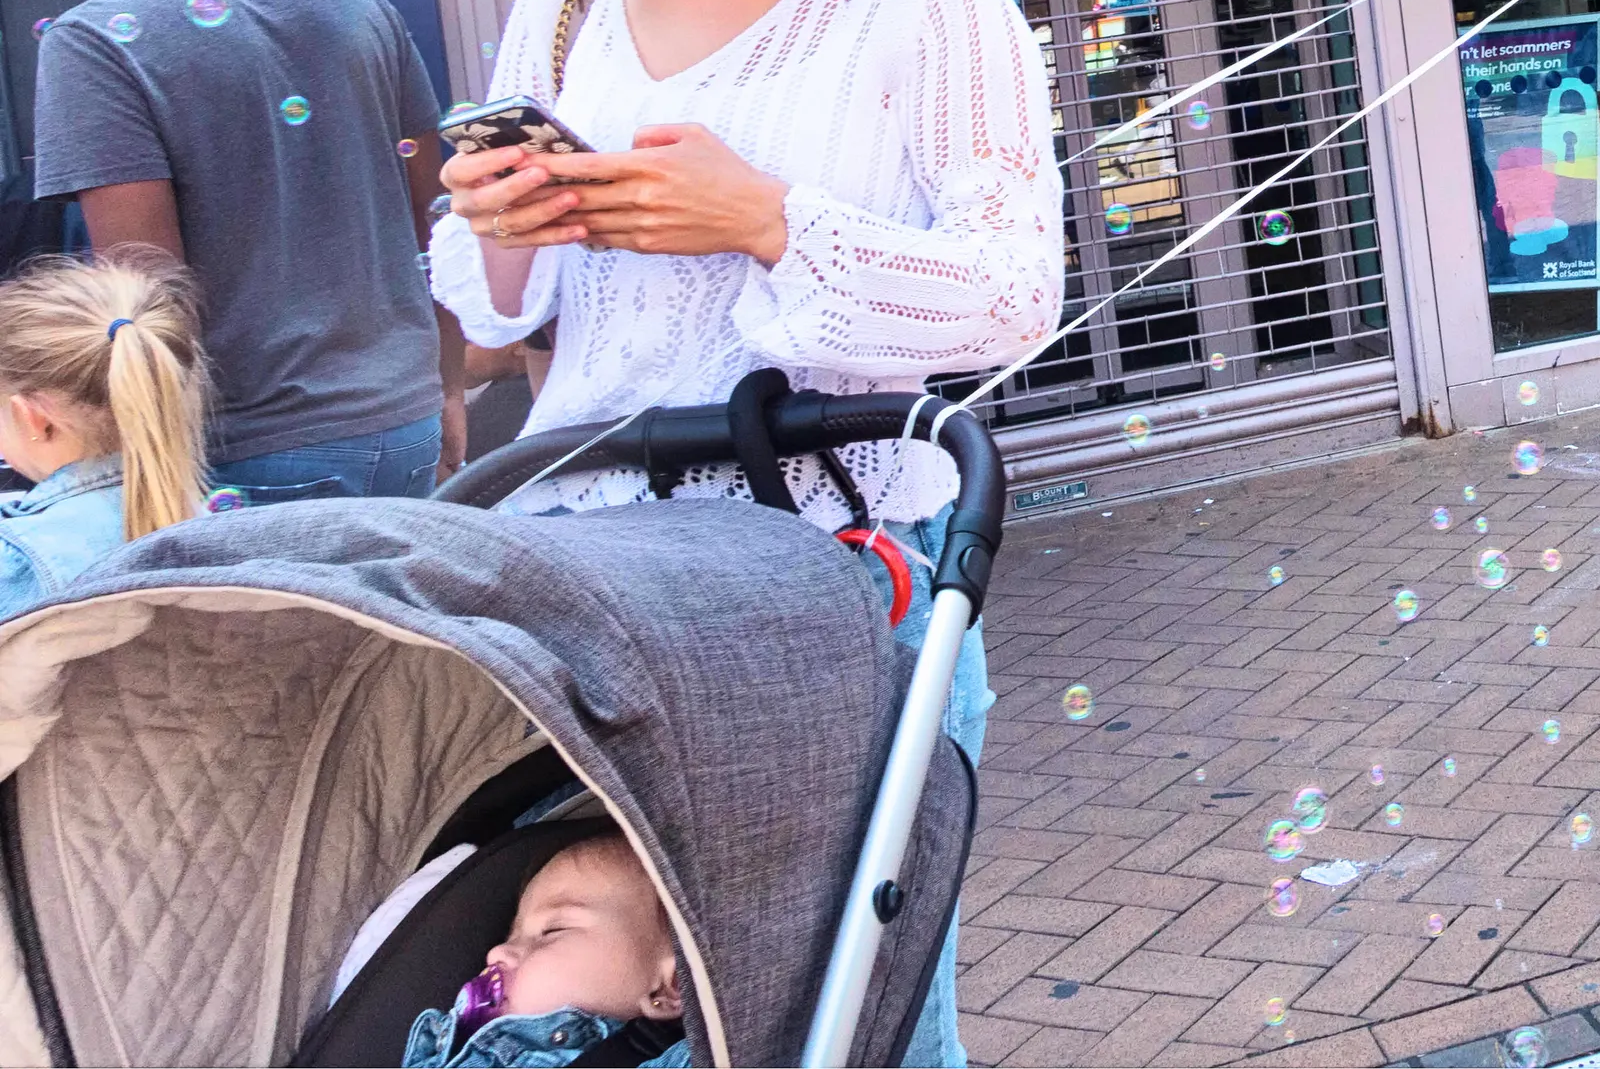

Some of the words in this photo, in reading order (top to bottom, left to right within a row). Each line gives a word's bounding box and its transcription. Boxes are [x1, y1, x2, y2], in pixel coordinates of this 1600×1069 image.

[1460, 47, 1479, 60] n't
[1481, 44, 1498, 59] let
[1499, 39, 1572, 56] scammers
[1465, 63, 1498, 77] their
[1500, 58, 1542, 73] hands
[1543, 58, 1562, 69] on
[1559, 261, 1578, 270] Royal
[1578, 260, 1595, 268] Bank
[1568, 269, 1596, 277] Scotland
